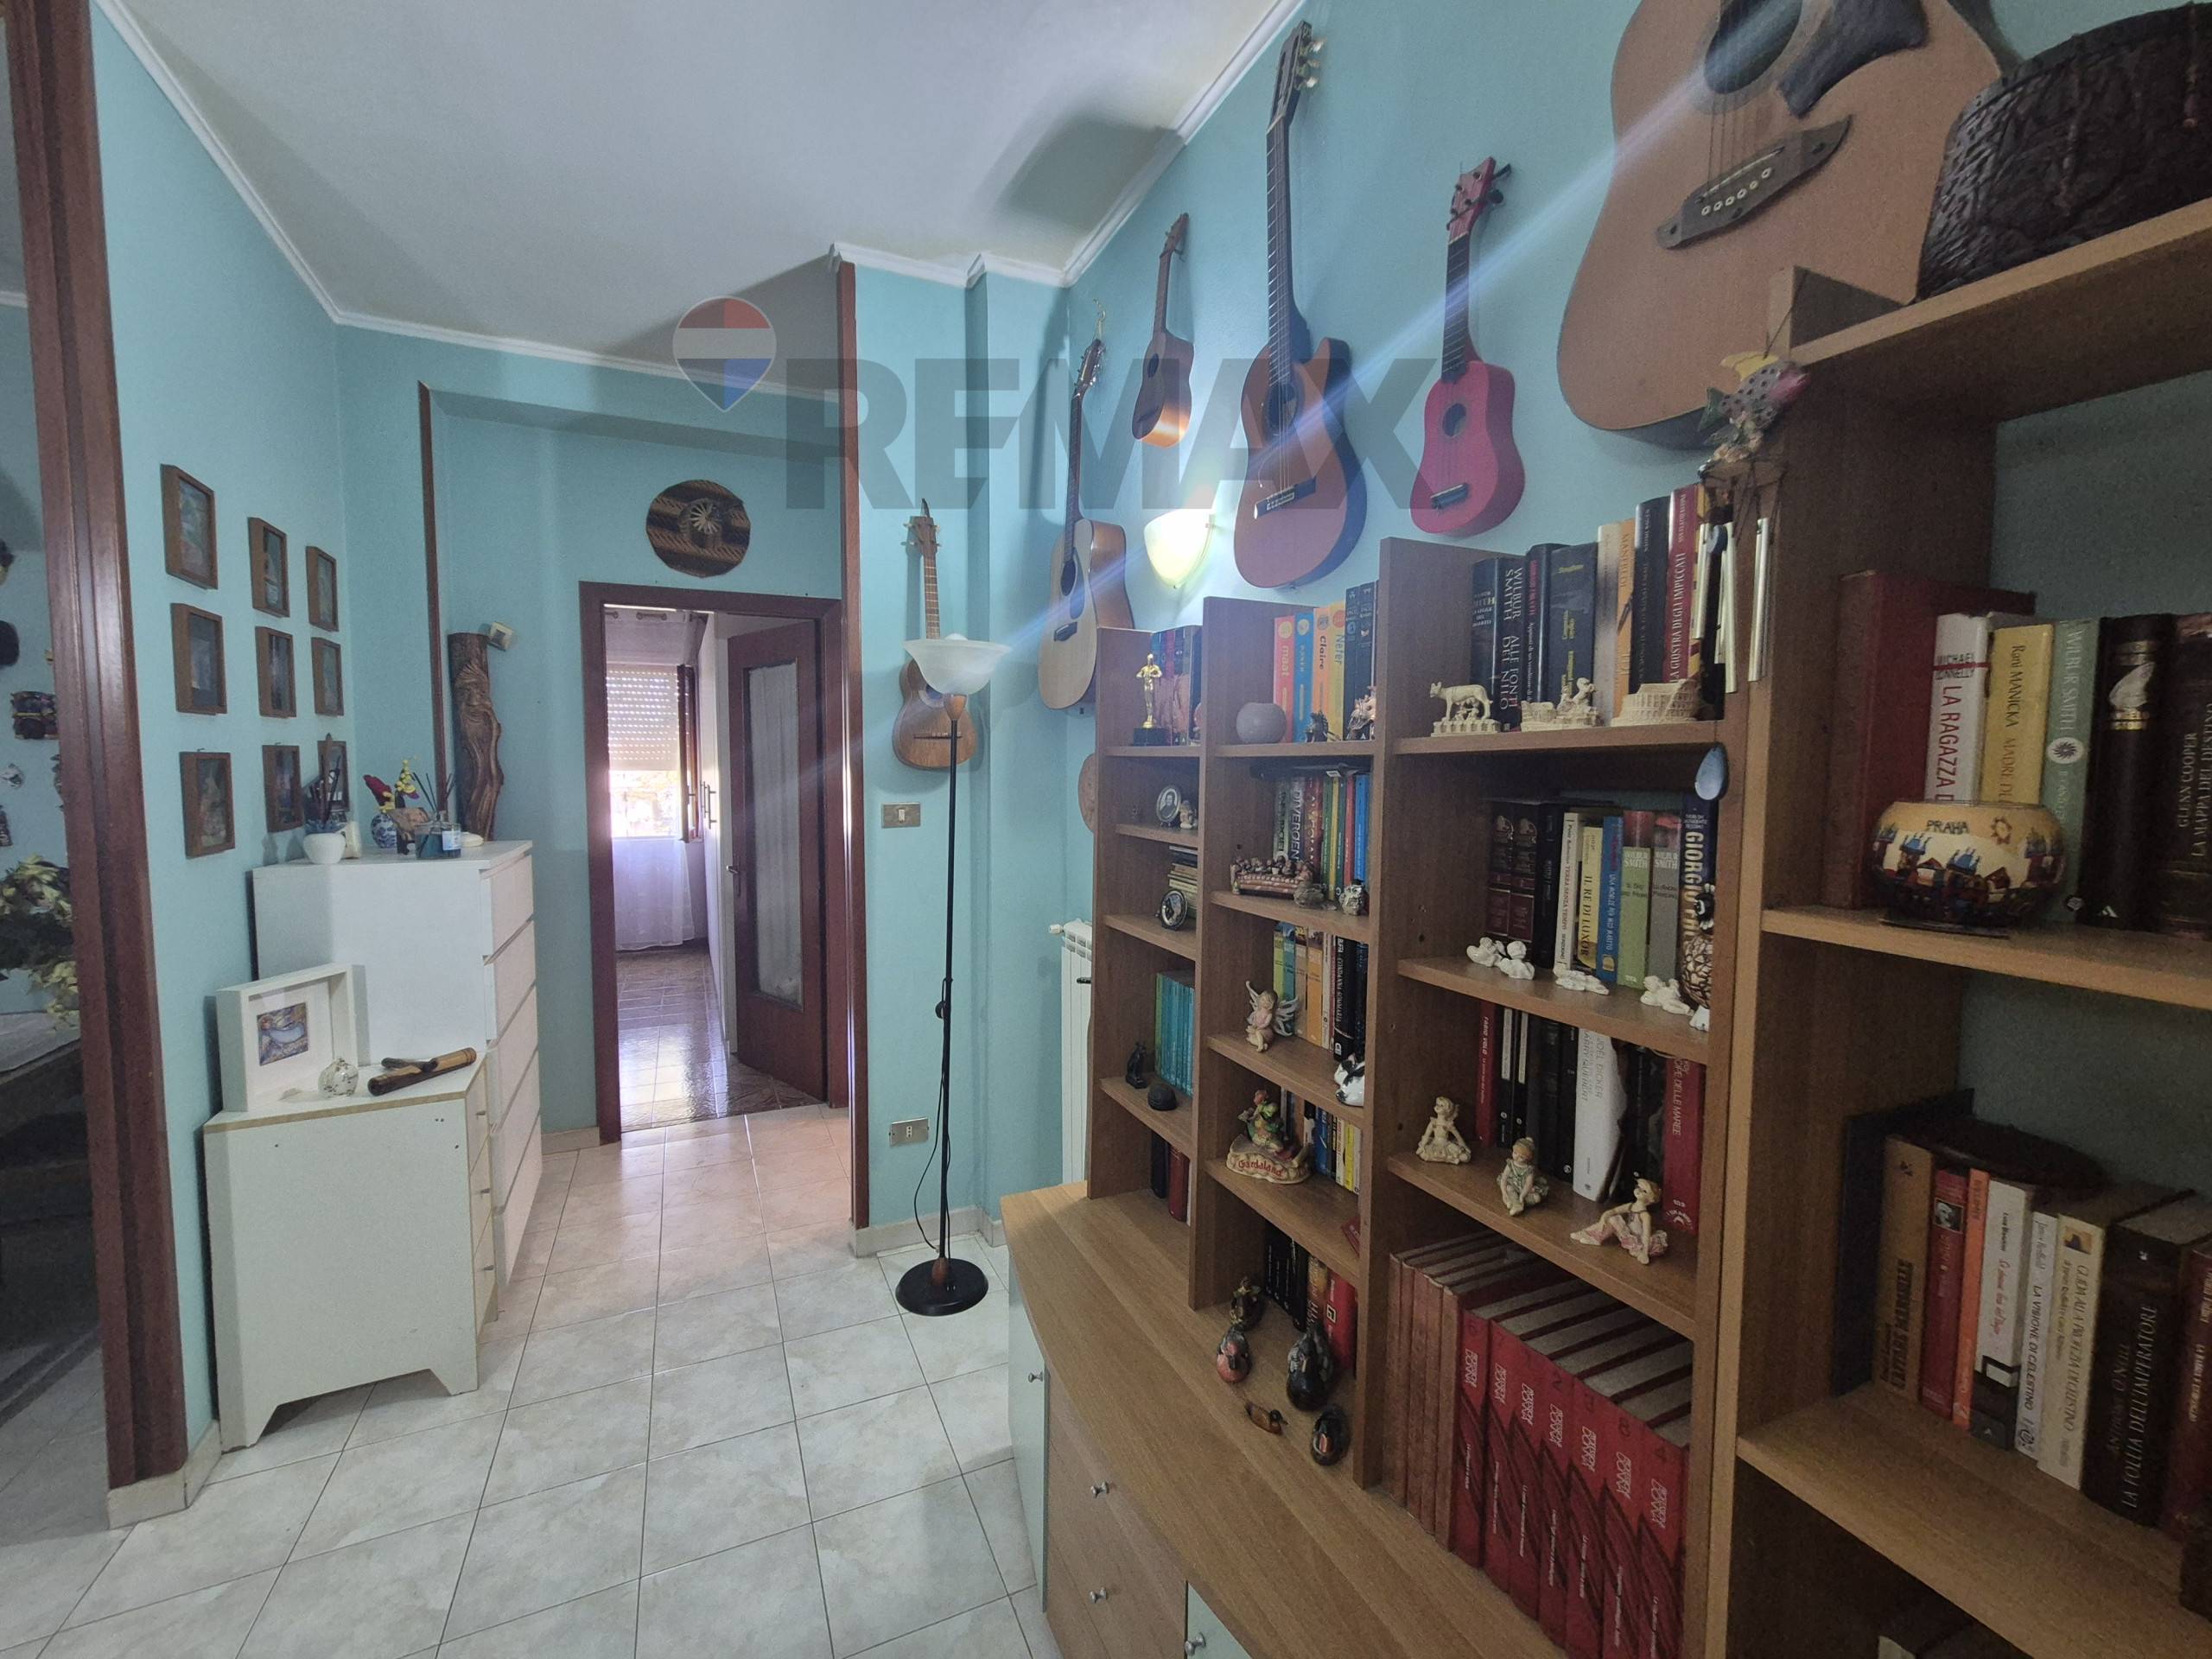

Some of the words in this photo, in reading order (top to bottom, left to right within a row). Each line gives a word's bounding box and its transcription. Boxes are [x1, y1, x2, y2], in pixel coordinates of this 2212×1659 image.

[1673, 552, 1687, 601] IMPICCATI
[1503, 568, 1514, 621] SMITH
[1512, 567, 1523, 620] WILBUR
[1671, 602, 1684, 629] DEGLI
[1280, 645, 1291, 677] maat
[1319, 635, 1327, 671] Claire
[1500, 636, 1510, 661] DEL
[1510, 635, 1520, 663] ALLE
[1670, 631, 1682, 670] GIOSTRA
[1499, 671, 1510, 710] NILO
[1942, 685, 1962, 706] LA
[2005, 671, 2024, 728] MANICKA
[1936, 712, 1961, 788] RAGAZZA
[2181, 732, 2198, 784] COOPER
[2177, 785, 2192, 829] GLENN
[1926, 818, 1971, 836] PRAHA
[1583, 888, 1592, 900] RE
[1585, 875, 1592, 885] IL
[1582, 904, 1592, 916] DI
[1581, 1029, 1592, 1057] ARRY
[1594, 1063, 1605, 1099] DICKER
[1672, 1078, 1682, 1104] DELLE
[1671, 1106, 1682, 1136] MAREE
[1238, 1159, 1284, 1177] Gardaland
[2031, 1285, 2044, 1299] LA
[2028, 1300, 2042, 1340] VISIONE
[2027, 1342, 2038, 1353] DI
[2023, 1354, 2037, 1411] CELESTINO
[2128, 1305, 2158, 1434] DELL'IMPERATORE
[2123, 1435, 2144, 1487] FOLLIA
[2121, 1491, 2138, 1509] LA
